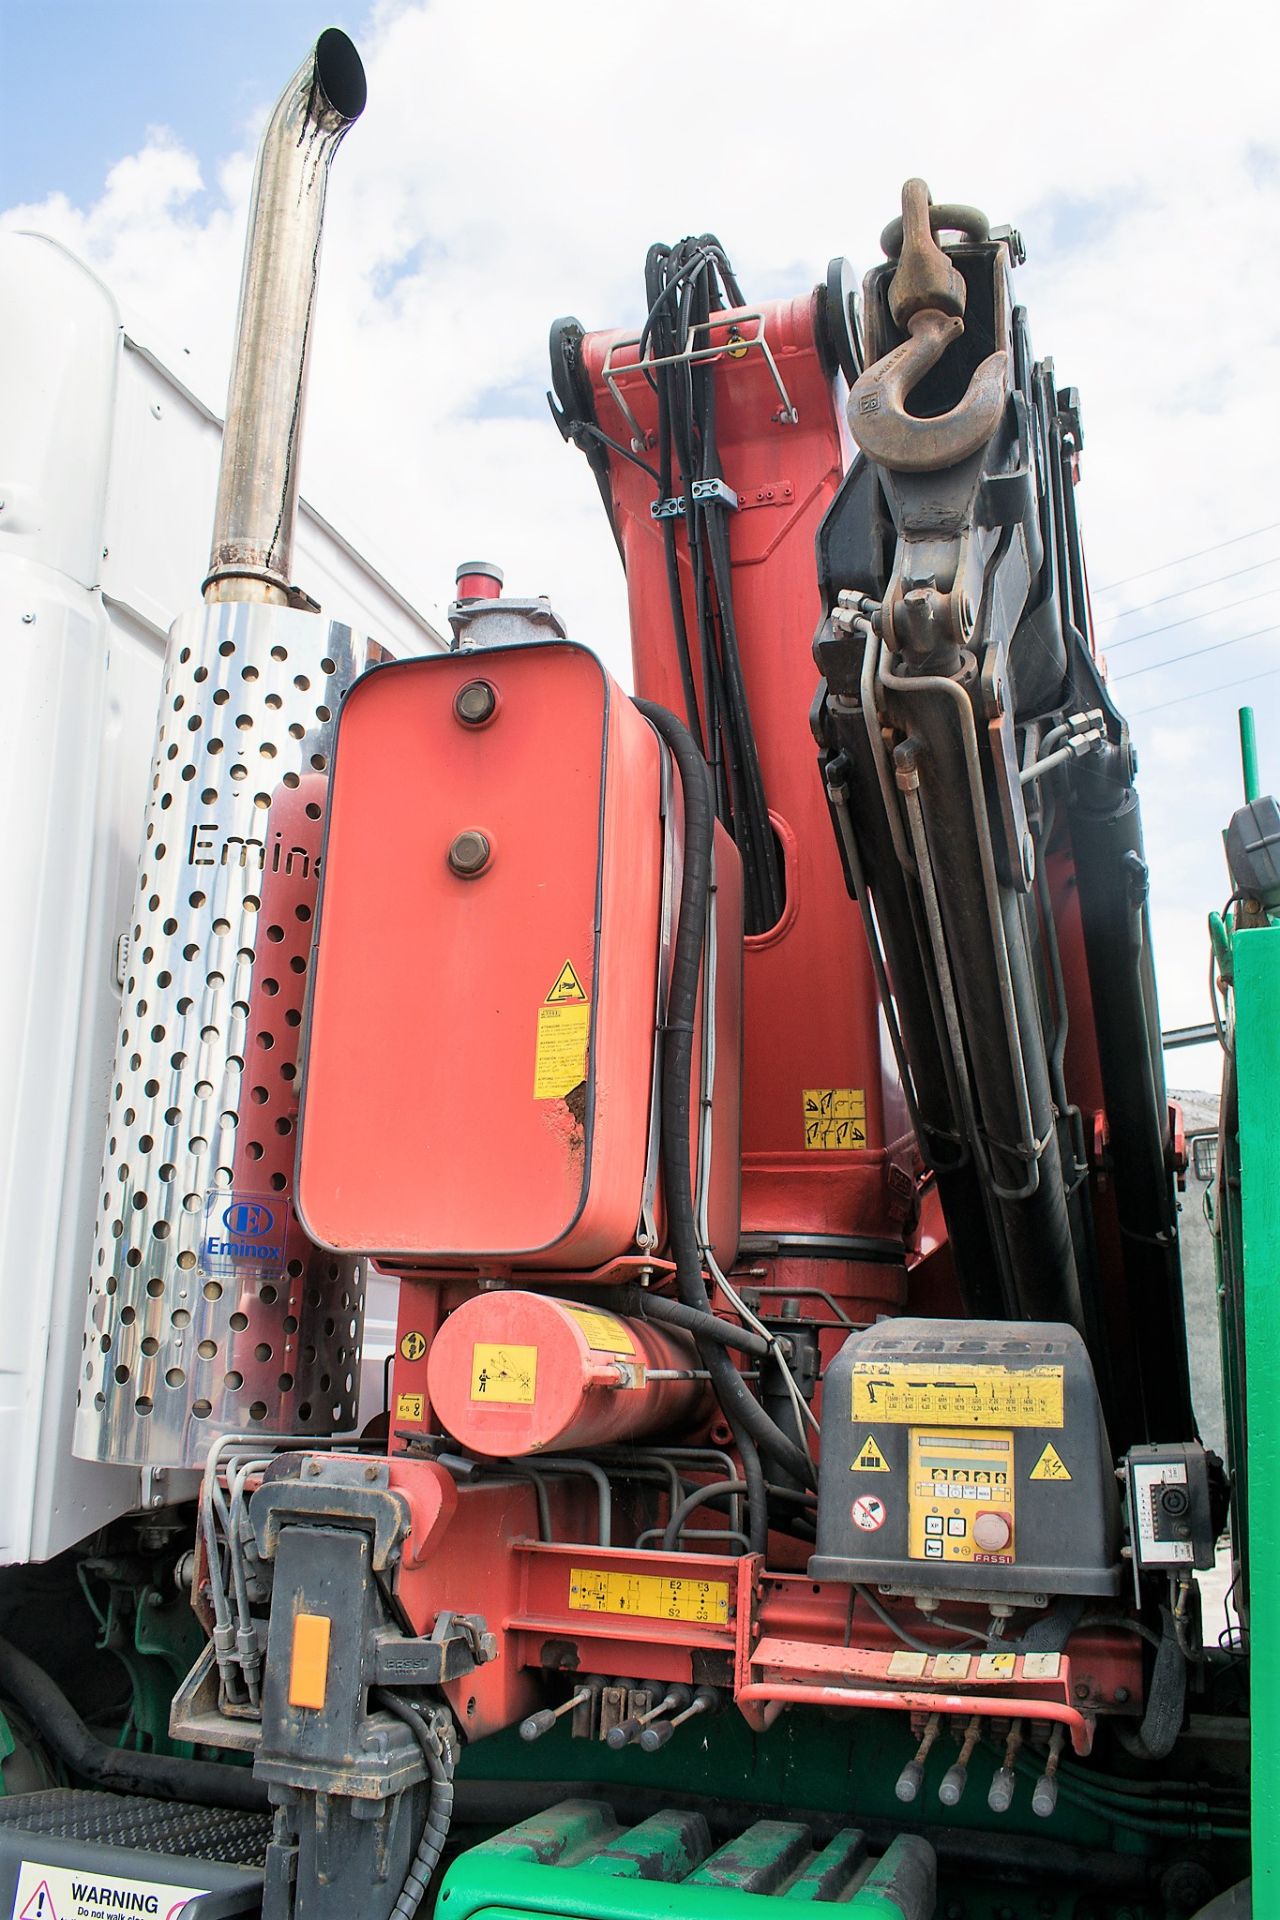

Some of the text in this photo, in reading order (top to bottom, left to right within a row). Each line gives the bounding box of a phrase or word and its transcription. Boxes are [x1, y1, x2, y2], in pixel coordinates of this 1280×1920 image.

[207, 1236, 281, 1260] Eminox
[975, 1555, 1010, 1563] FASSI
[670, 1580, 682, 1590] E2
[668, 1608, 681, 1617] S2
[72, 1882, 159, 1914] WARNING
[78, 1906, 88, 1916] Do
[91, 1911, 104, 1919] not
